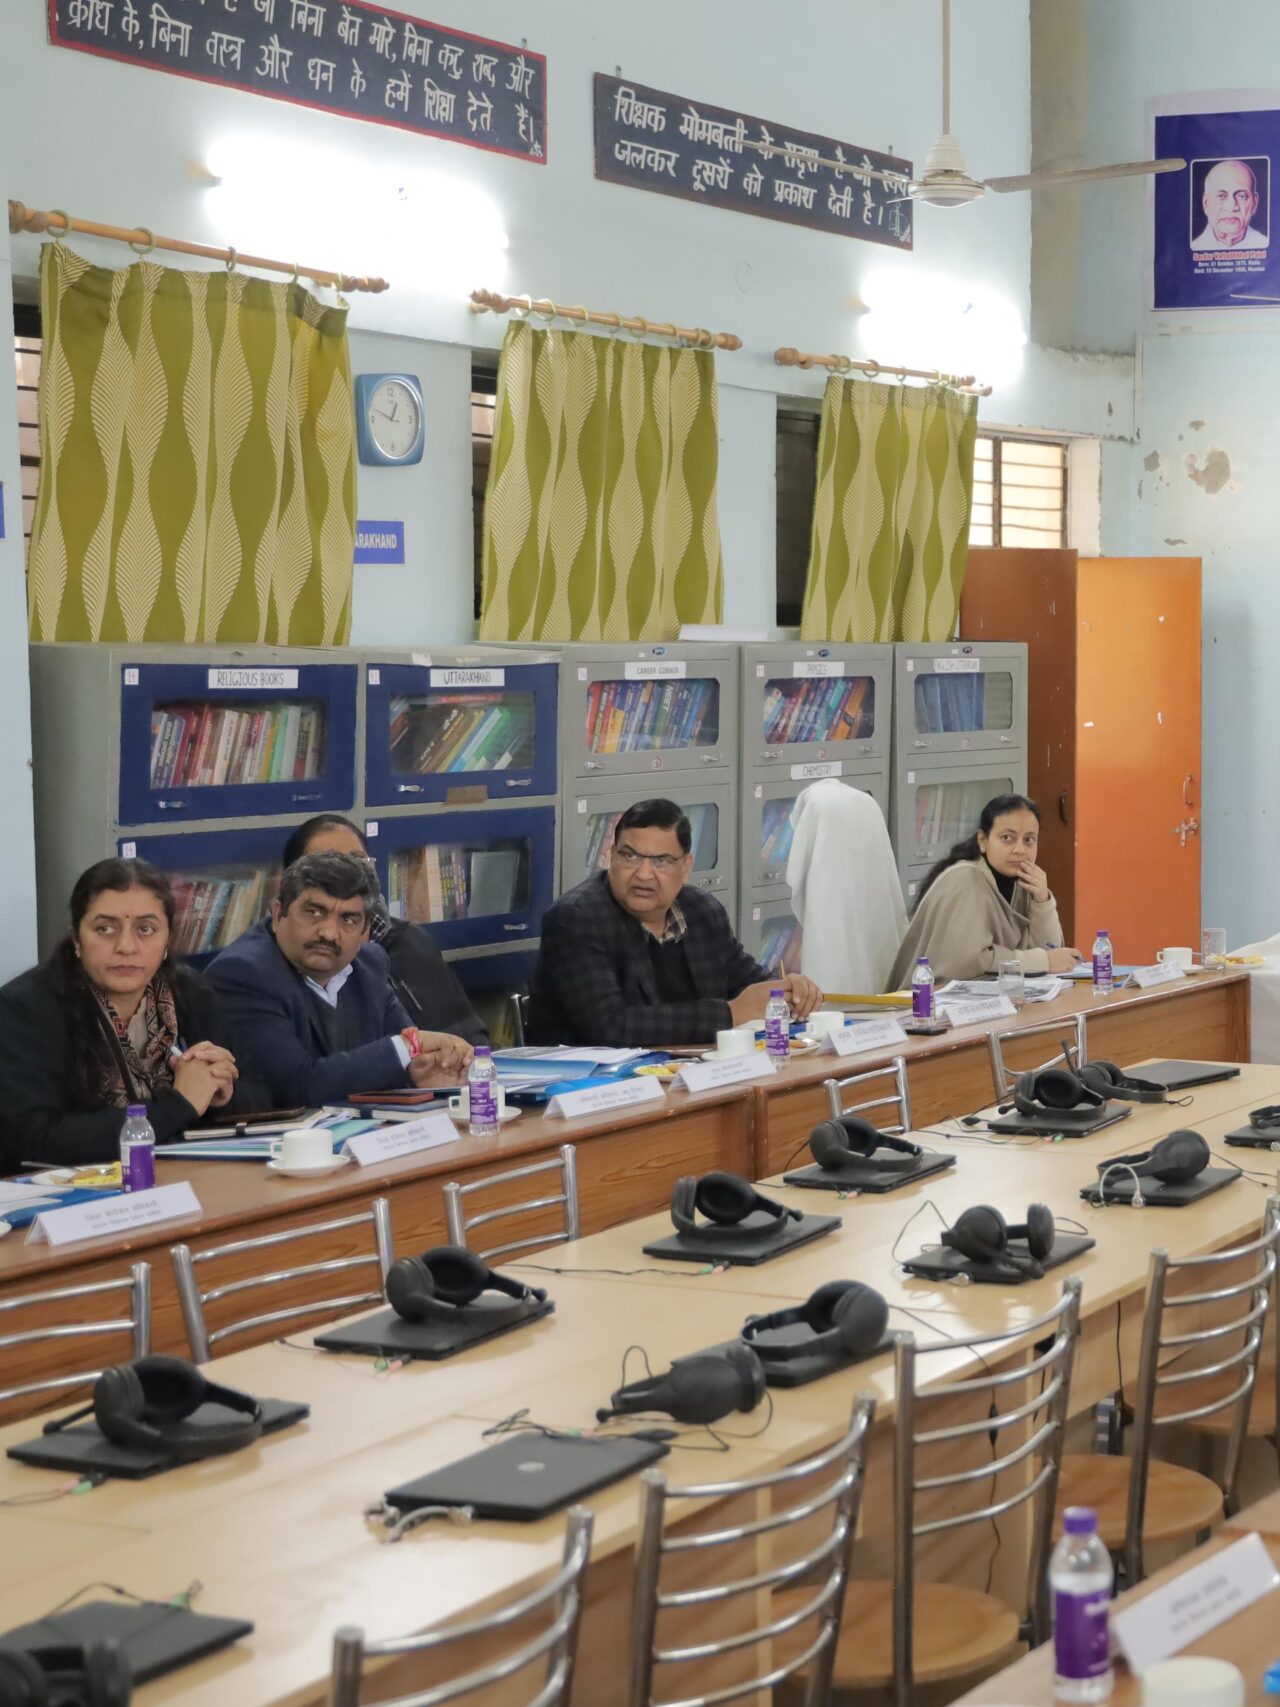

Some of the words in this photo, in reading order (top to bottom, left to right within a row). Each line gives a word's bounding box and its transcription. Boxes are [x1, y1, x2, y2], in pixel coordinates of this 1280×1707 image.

[149, 2, 193, 58] बिना
[254, 33, 294, 84] और
[307, 57, 336, 94] धन
[350, 57, 367, 99] के
[402, 22, 434, 67] बिना
[505, 55, 536, 99] और
[613, 86, 667, 134] शिक्षक
[613, 138, 680, 178] जलकर
[742, 163, 764, 198] को
[773, 178, 819, 211] प्रकाश
[826, 184, 854, 219] देती
[216, 670, 259, 687] RELIGIOUS
[259, 670, 285, 685] BOOKS
[443, 670, 492, 686] UTTARAKHAND
